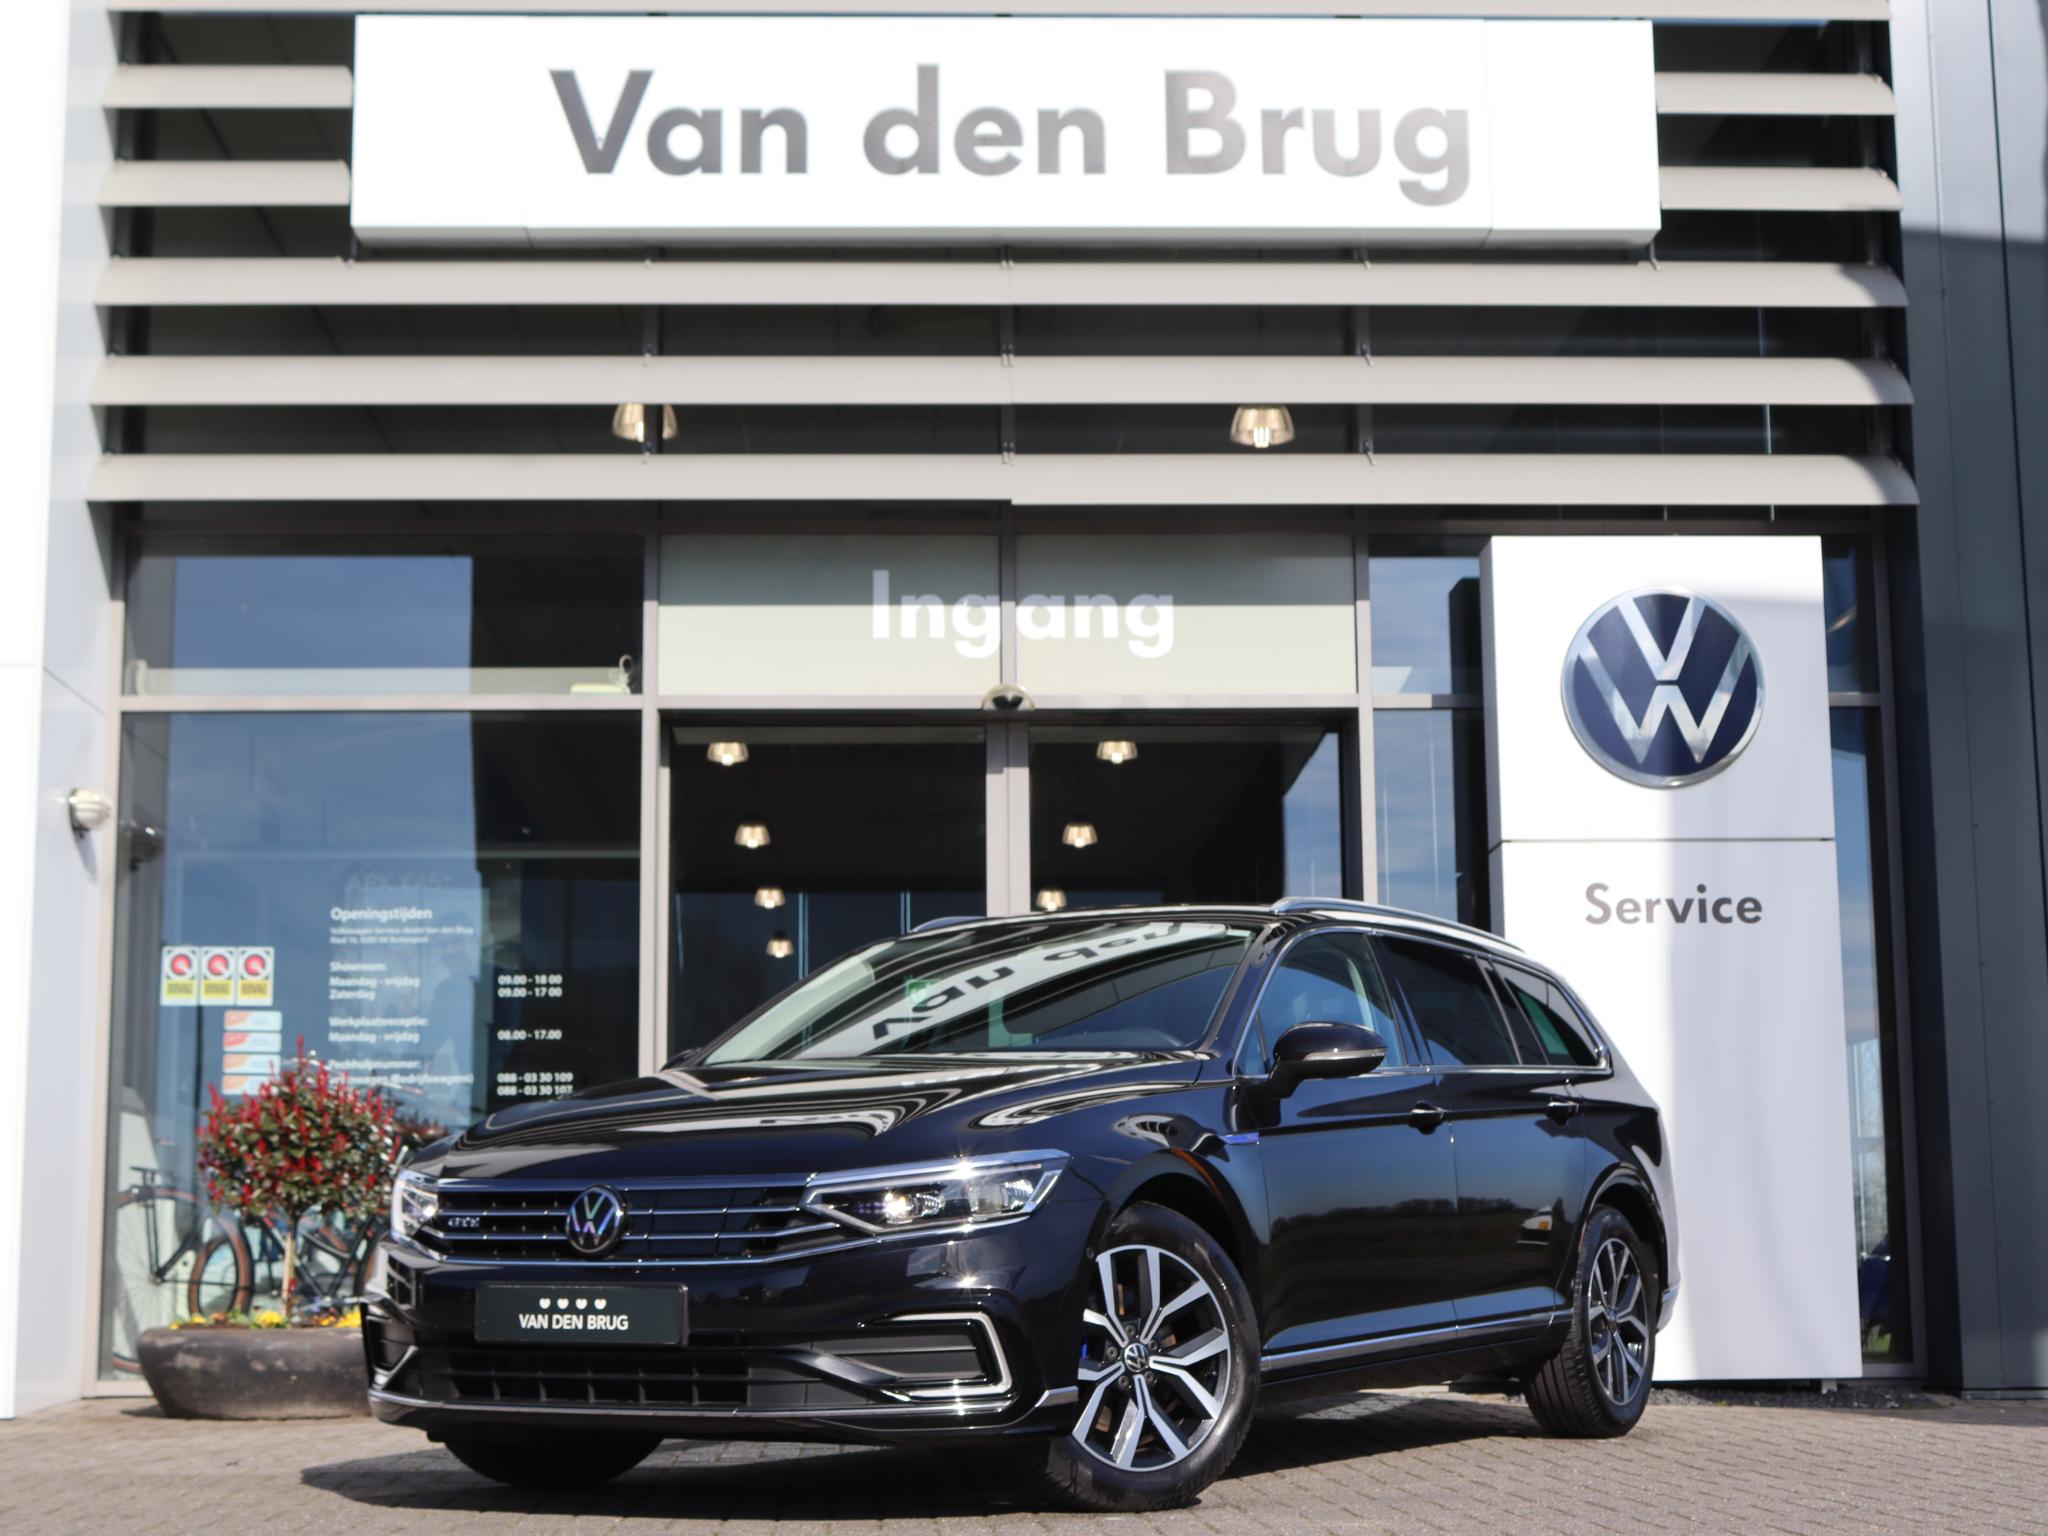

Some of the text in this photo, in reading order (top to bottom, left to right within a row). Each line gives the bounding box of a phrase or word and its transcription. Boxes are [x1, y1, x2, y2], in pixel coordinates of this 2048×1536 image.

[549, 63, 1470, 207] Van den Brug
[872, 569, 1175, 659] Ingang
[1585, 883, 1763, 925] Service
[330, 905, 433, 922] Openingstijden
[329, 976, 378, 989] Maandag
[384, 976, 421, 989] vrijdag
[329, 988, 376, 1000] Zaterdag
[328, 1031, 377, 1044] Maandag
[383, 1031, 420, 1044] vrijdag
[497, 1072, 518, 1083] 088
[523, 1072, 538, 1083] 03
[539, 1072, 553, 1083] 30
[554, 1072, 574, 1083] 109
[497, 1084, 518, 1096] 088
[523, 1084, 538, 1096] 03
[539, 1084, 553, 1096] 30
[518, 1314, 629, 1330] VAN DEN BRUG
